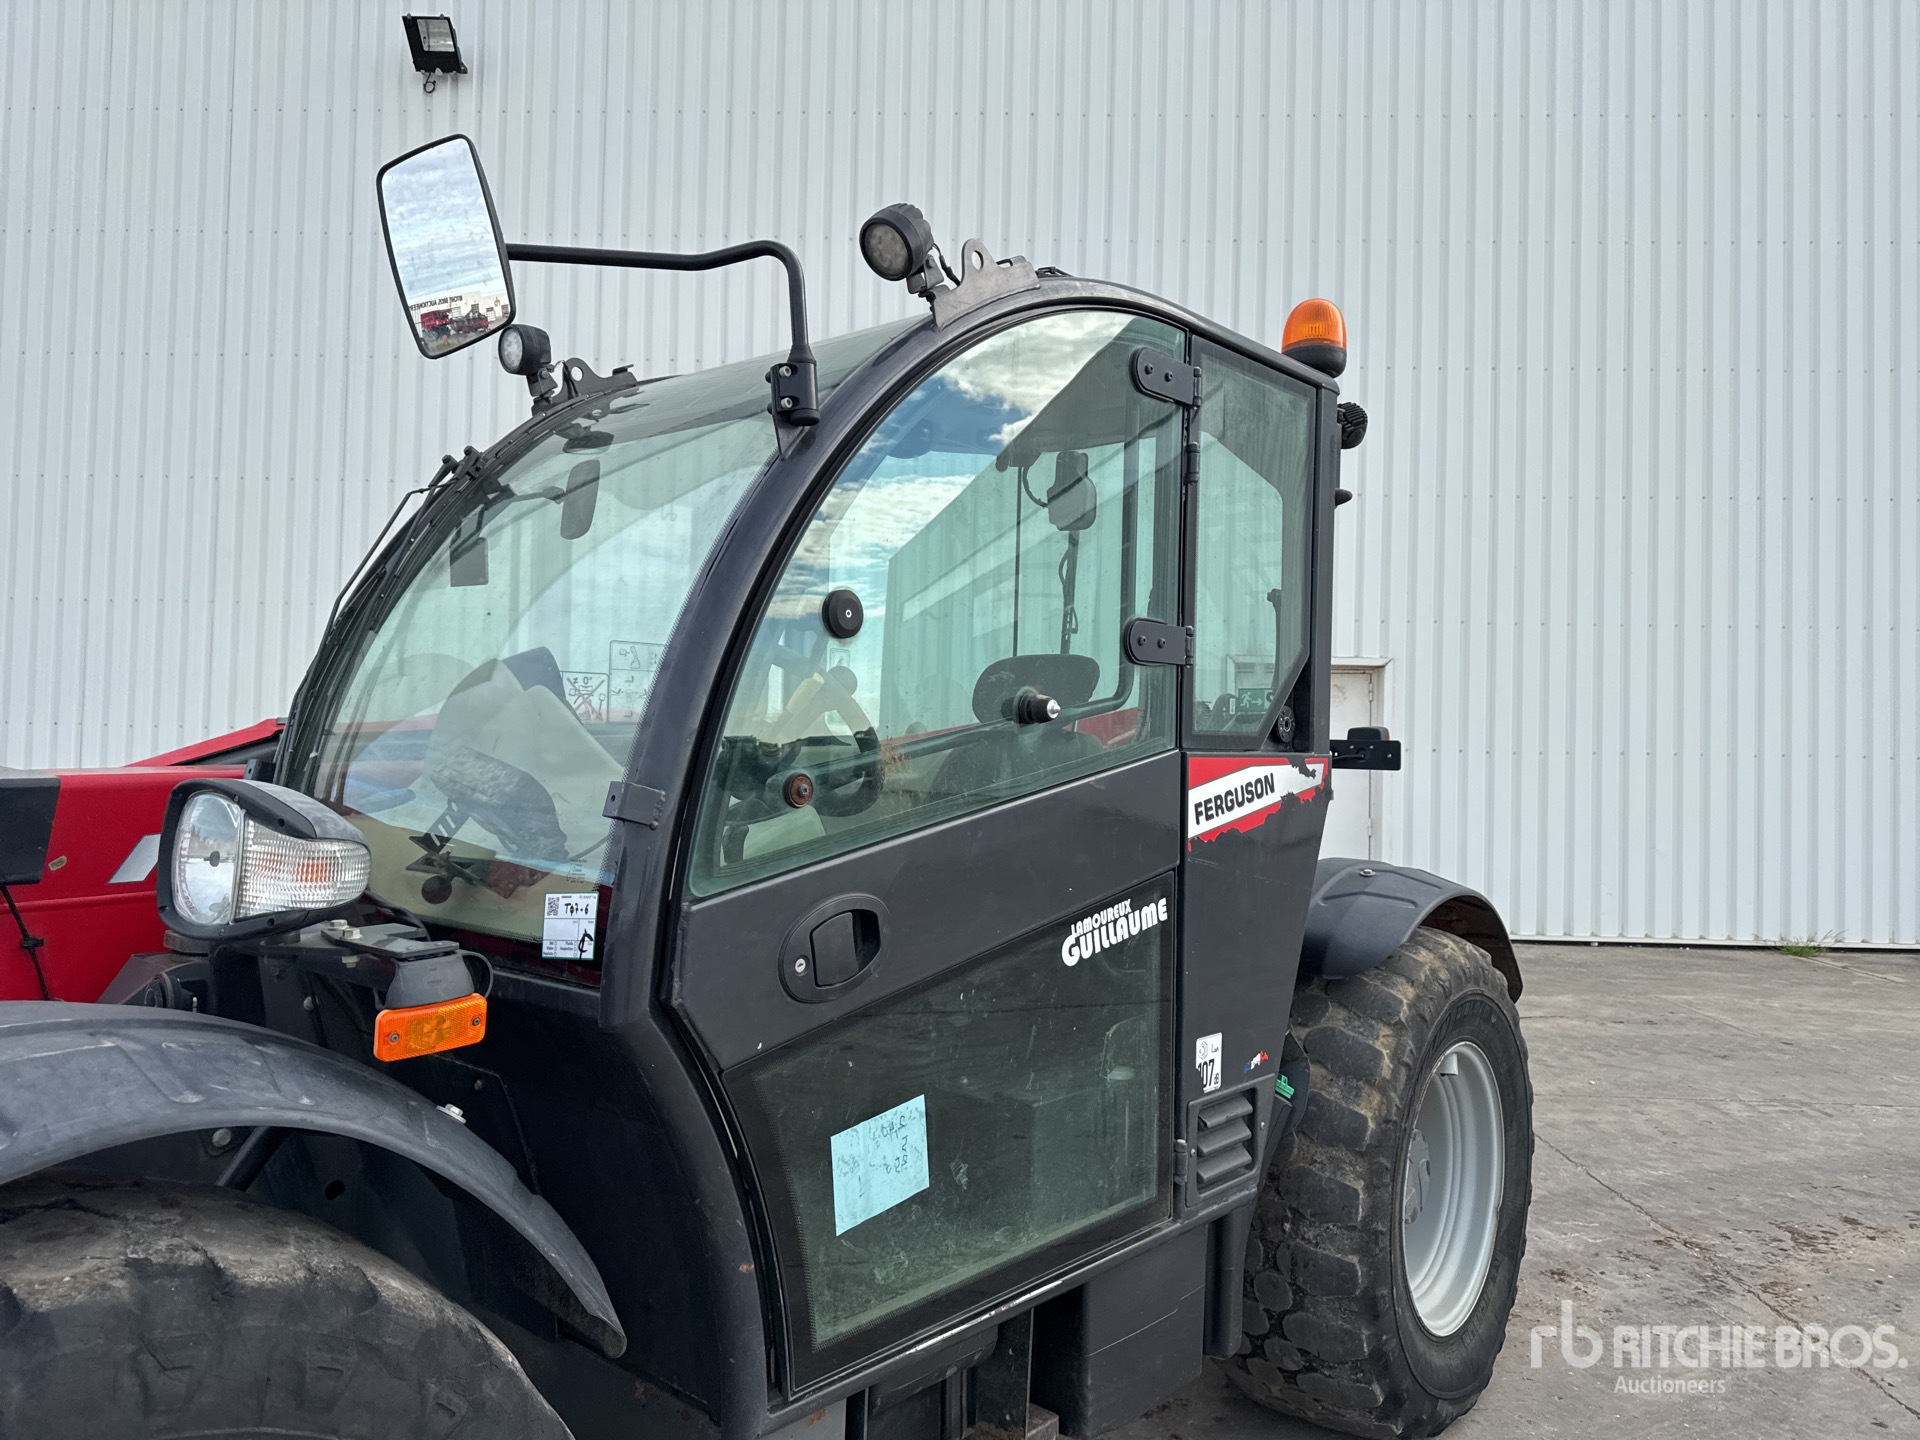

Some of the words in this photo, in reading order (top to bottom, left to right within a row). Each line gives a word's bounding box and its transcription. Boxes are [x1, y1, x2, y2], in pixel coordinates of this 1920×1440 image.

[1194, 772, 1276, 826] FERGUSON
[1061, 896, 1168, 967] GUILLAUME
[1070, 898, 1132, 938] LAMOUREUX
